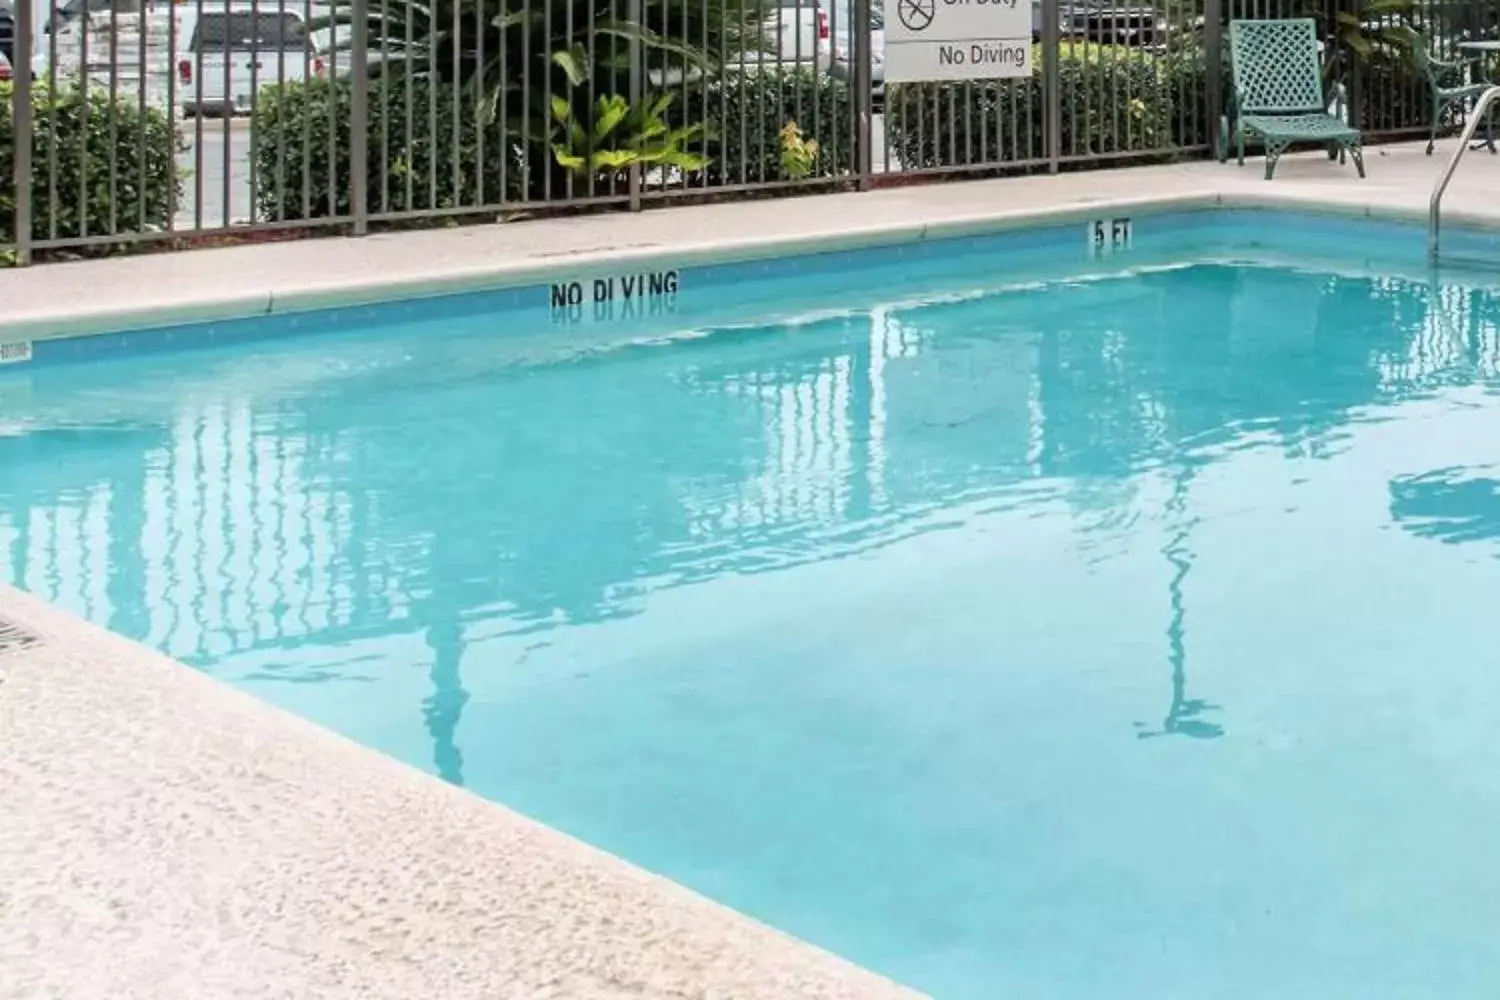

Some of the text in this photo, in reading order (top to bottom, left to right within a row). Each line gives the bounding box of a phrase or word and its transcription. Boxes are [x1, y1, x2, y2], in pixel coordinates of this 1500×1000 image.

[938, 42, 1025, 67] No Diving
[551, 271, 678, 308] NO DIVING
